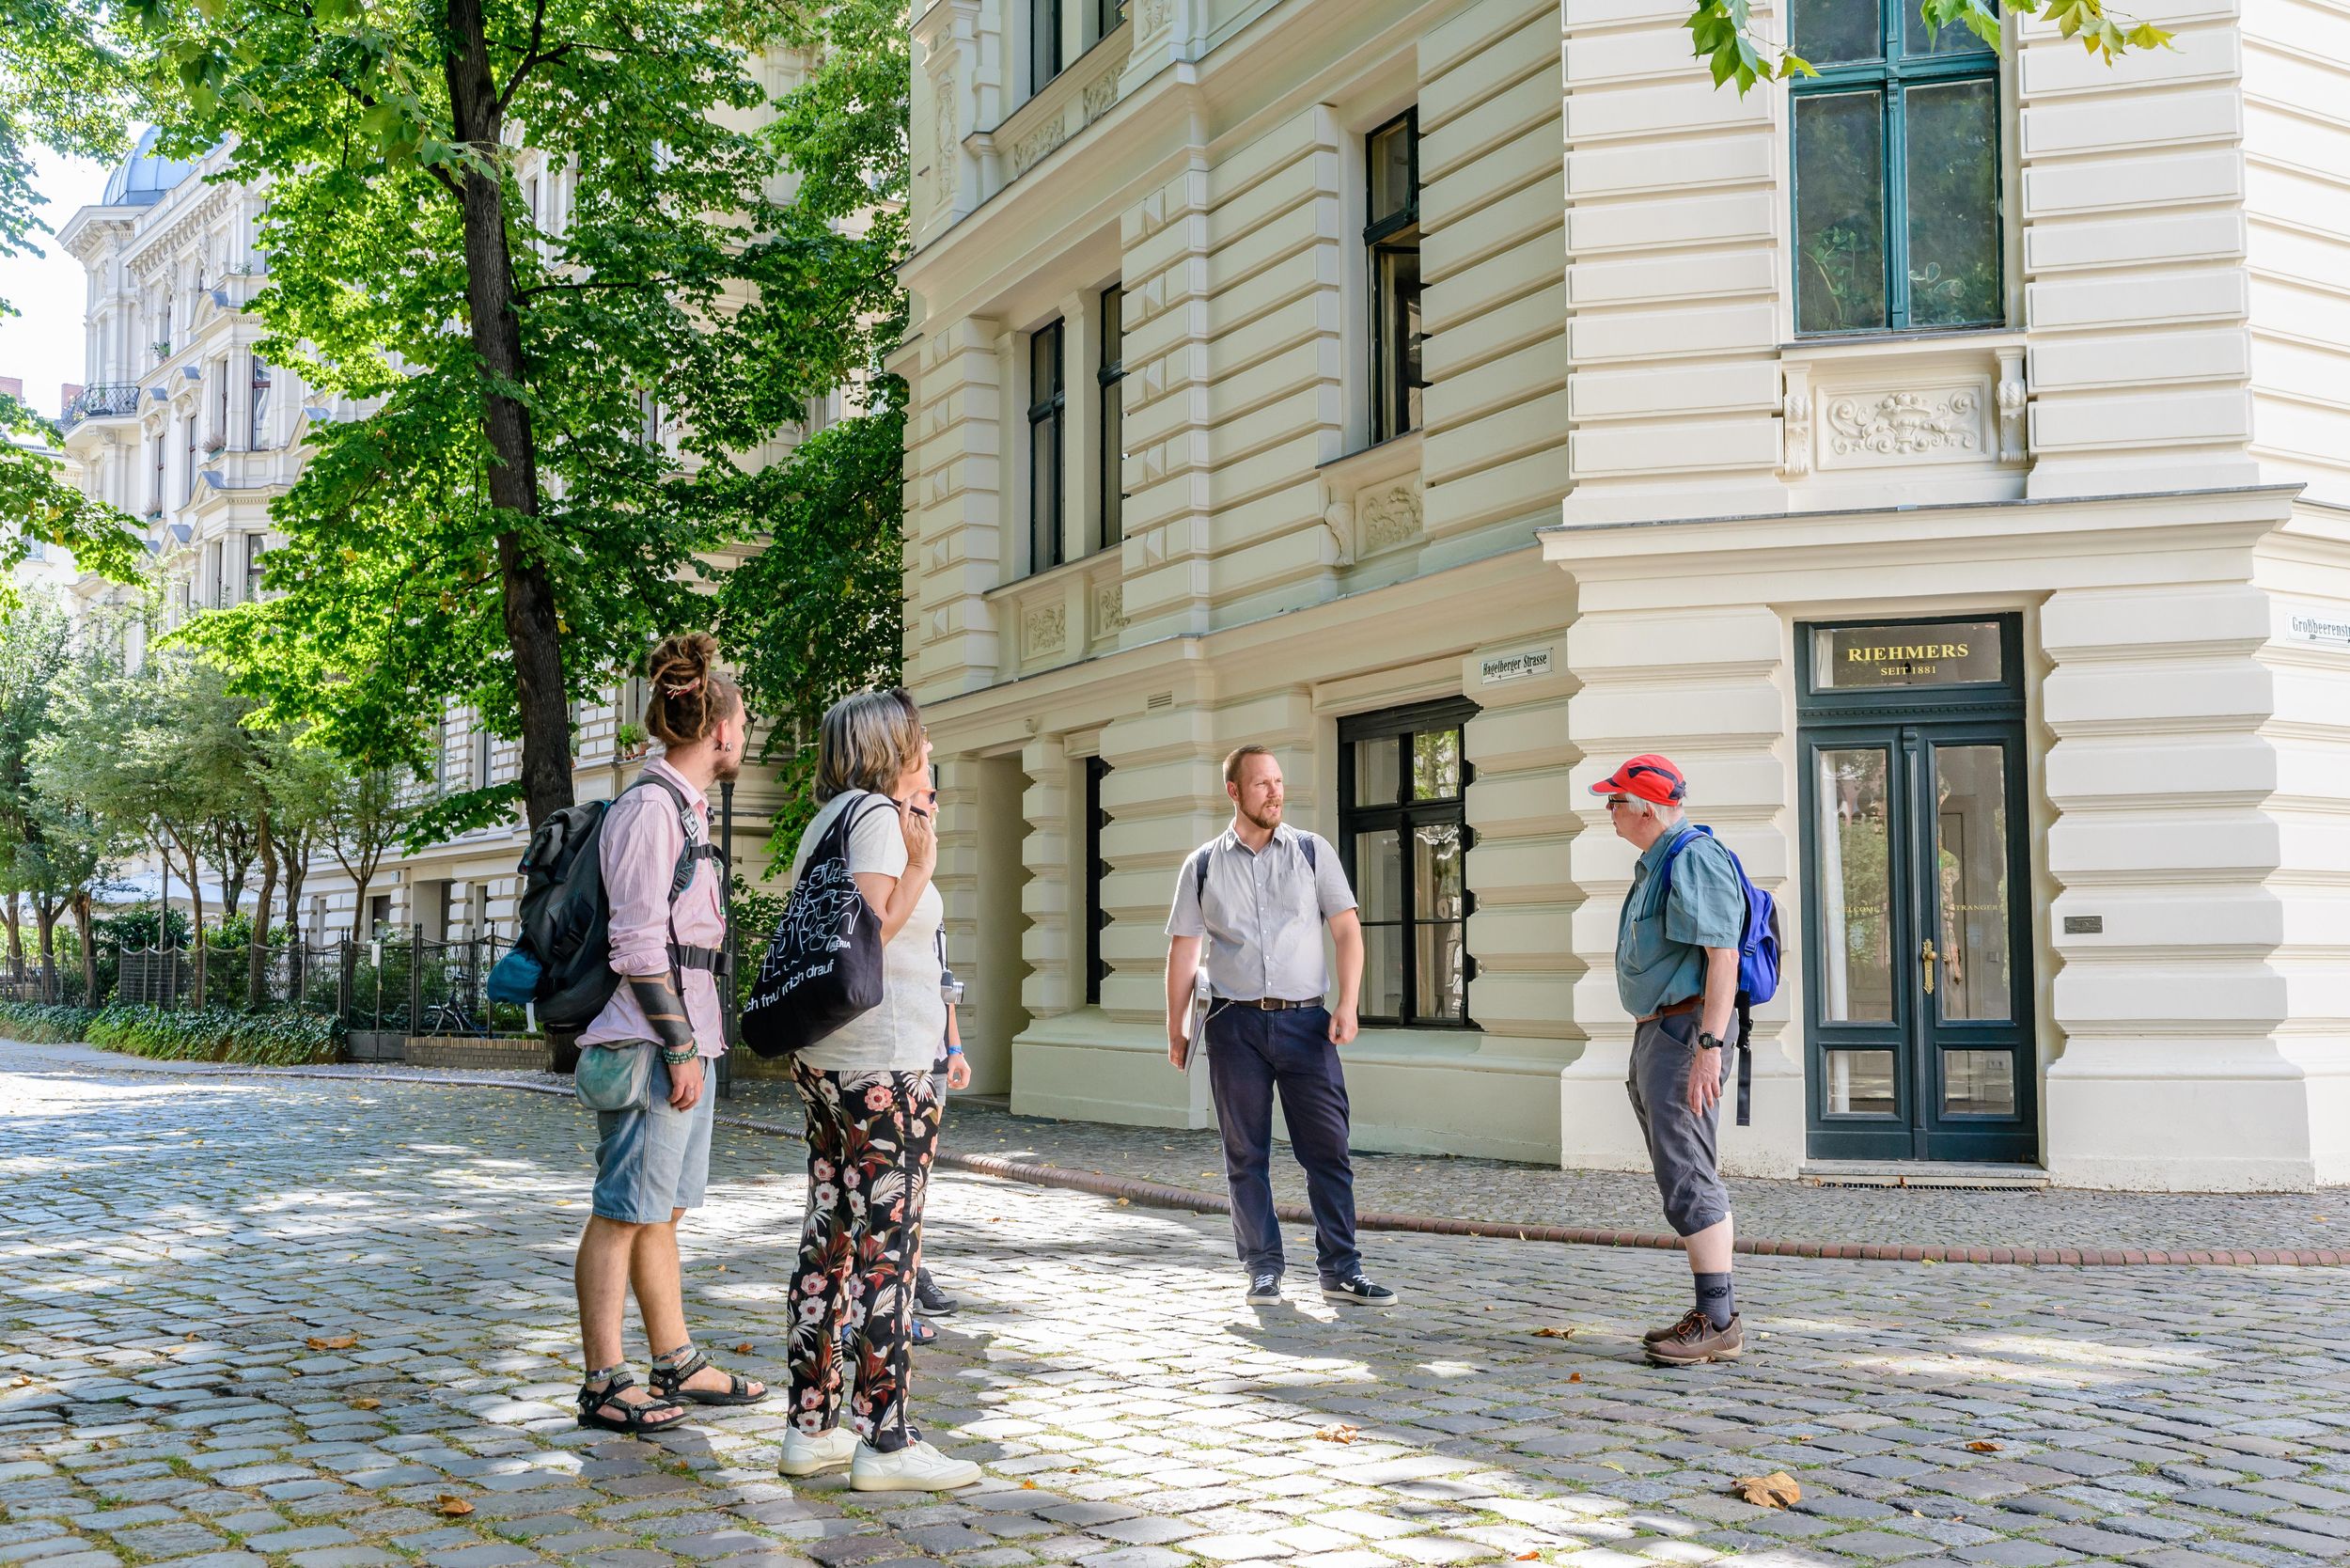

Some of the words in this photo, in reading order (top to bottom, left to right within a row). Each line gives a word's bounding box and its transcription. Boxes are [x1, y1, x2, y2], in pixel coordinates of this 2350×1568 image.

[1848, 643, 1969, 662] RIEHMERS
[1482, 658, 1521, 677] Hagelberger
[1523, 653, 1547, 668] Strasse
[1881, 666, 1908, 675] SEIT
[1912, 666, 1935, 675] 1881
[744, 997, 759, 1012] ch
[806, 959, 835, 979] drauf
